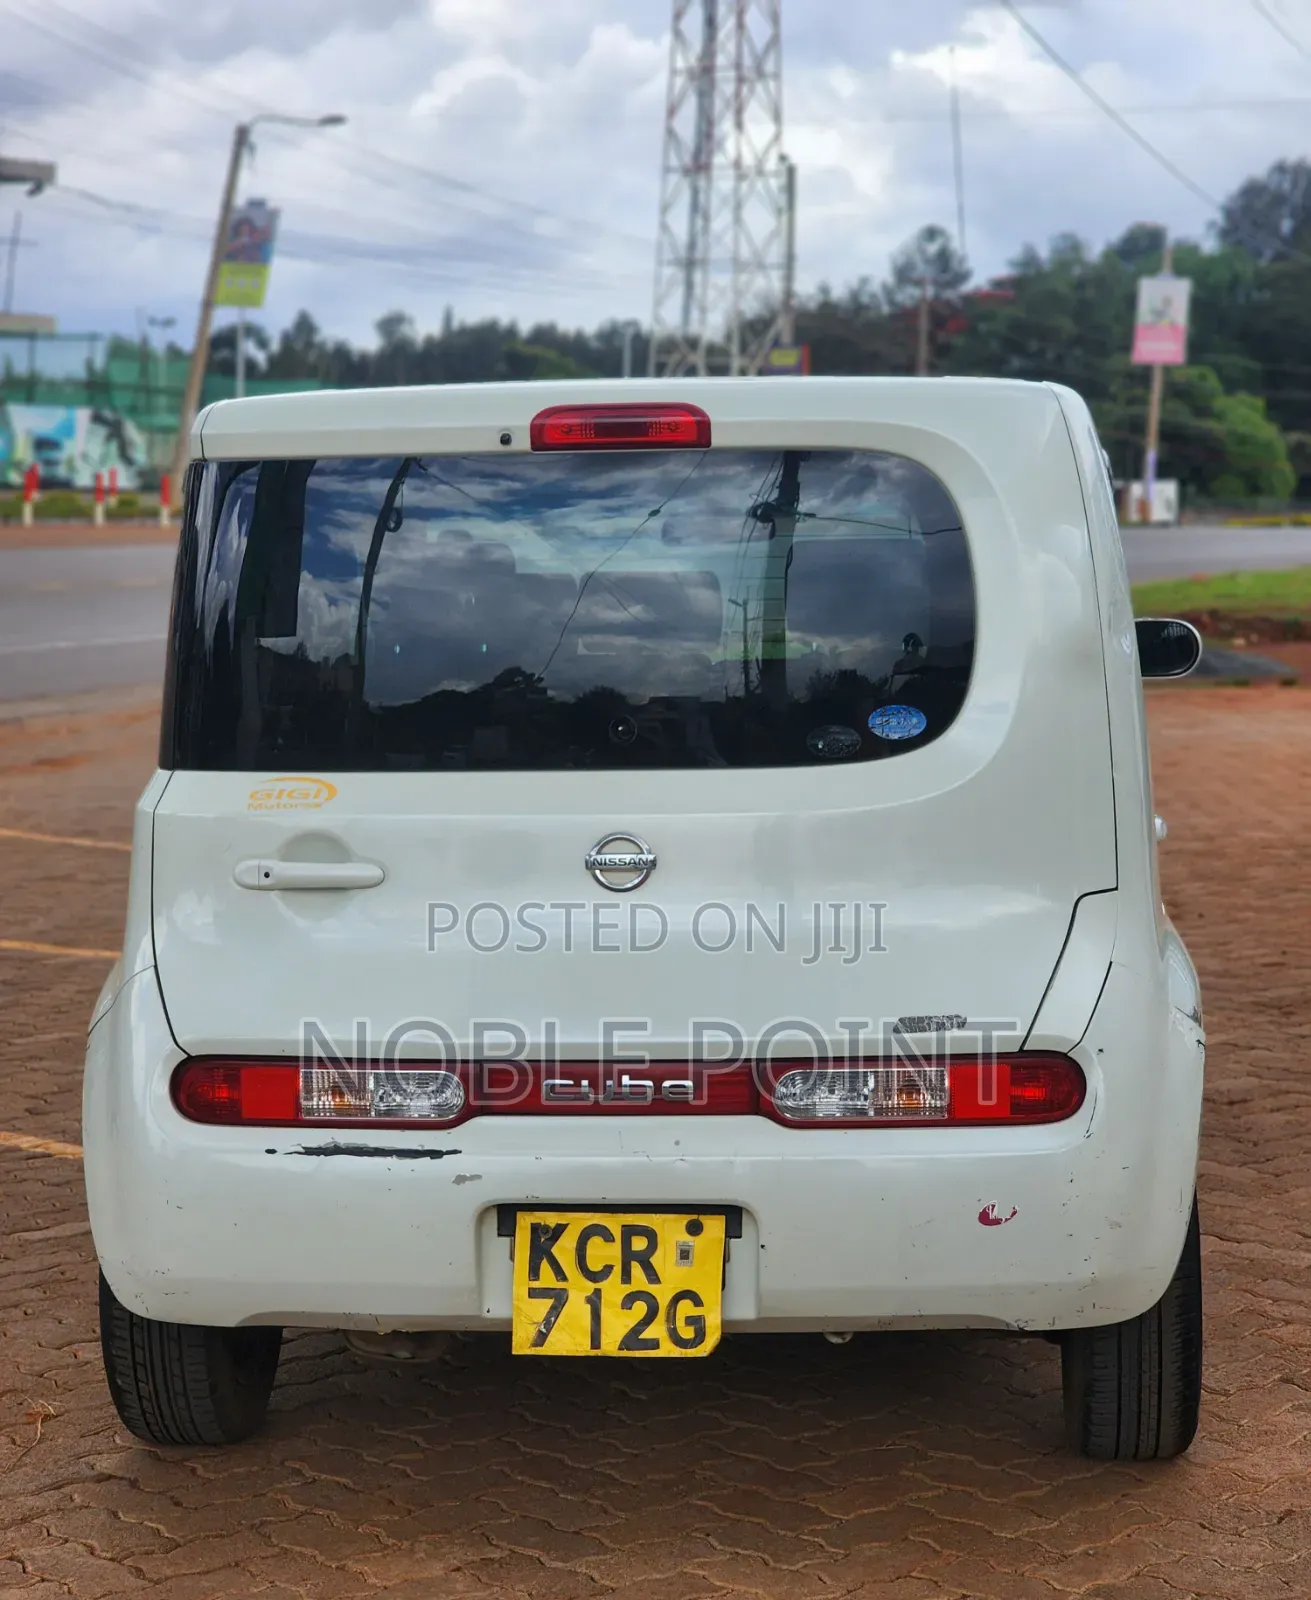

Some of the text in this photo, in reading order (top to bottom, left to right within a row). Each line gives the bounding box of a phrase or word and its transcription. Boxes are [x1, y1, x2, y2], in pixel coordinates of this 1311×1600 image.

[249, 788, 322, 800] GIGI
[592, 857, 649, 867] NISSAN
[543, 1075, 693, 1101] cube
[528, 1222, 662, 1285] KCR
[528, 1288, 706, 1351] 712G
